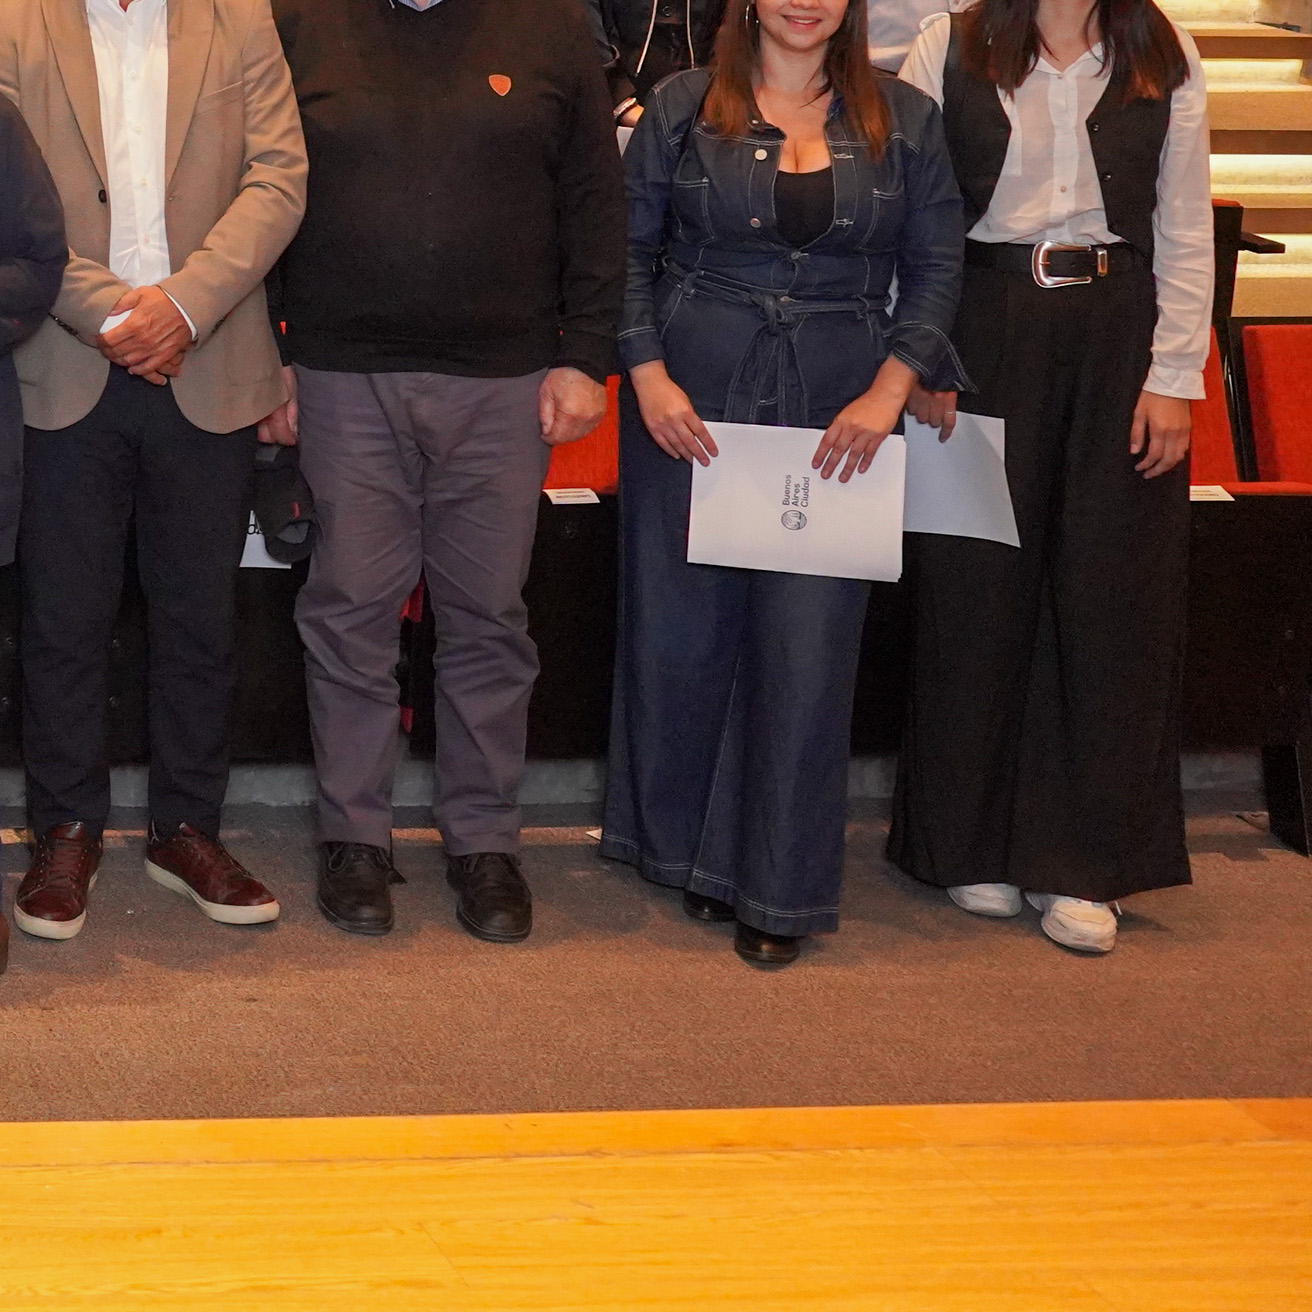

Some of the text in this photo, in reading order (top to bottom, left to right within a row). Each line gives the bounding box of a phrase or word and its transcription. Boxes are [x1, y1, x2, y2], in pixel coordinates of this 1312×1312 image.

[781, 474, 792, 506] Buenos
[791, 483, 801, 507] Aires
[800, 476, 810, 508] Ciudad
